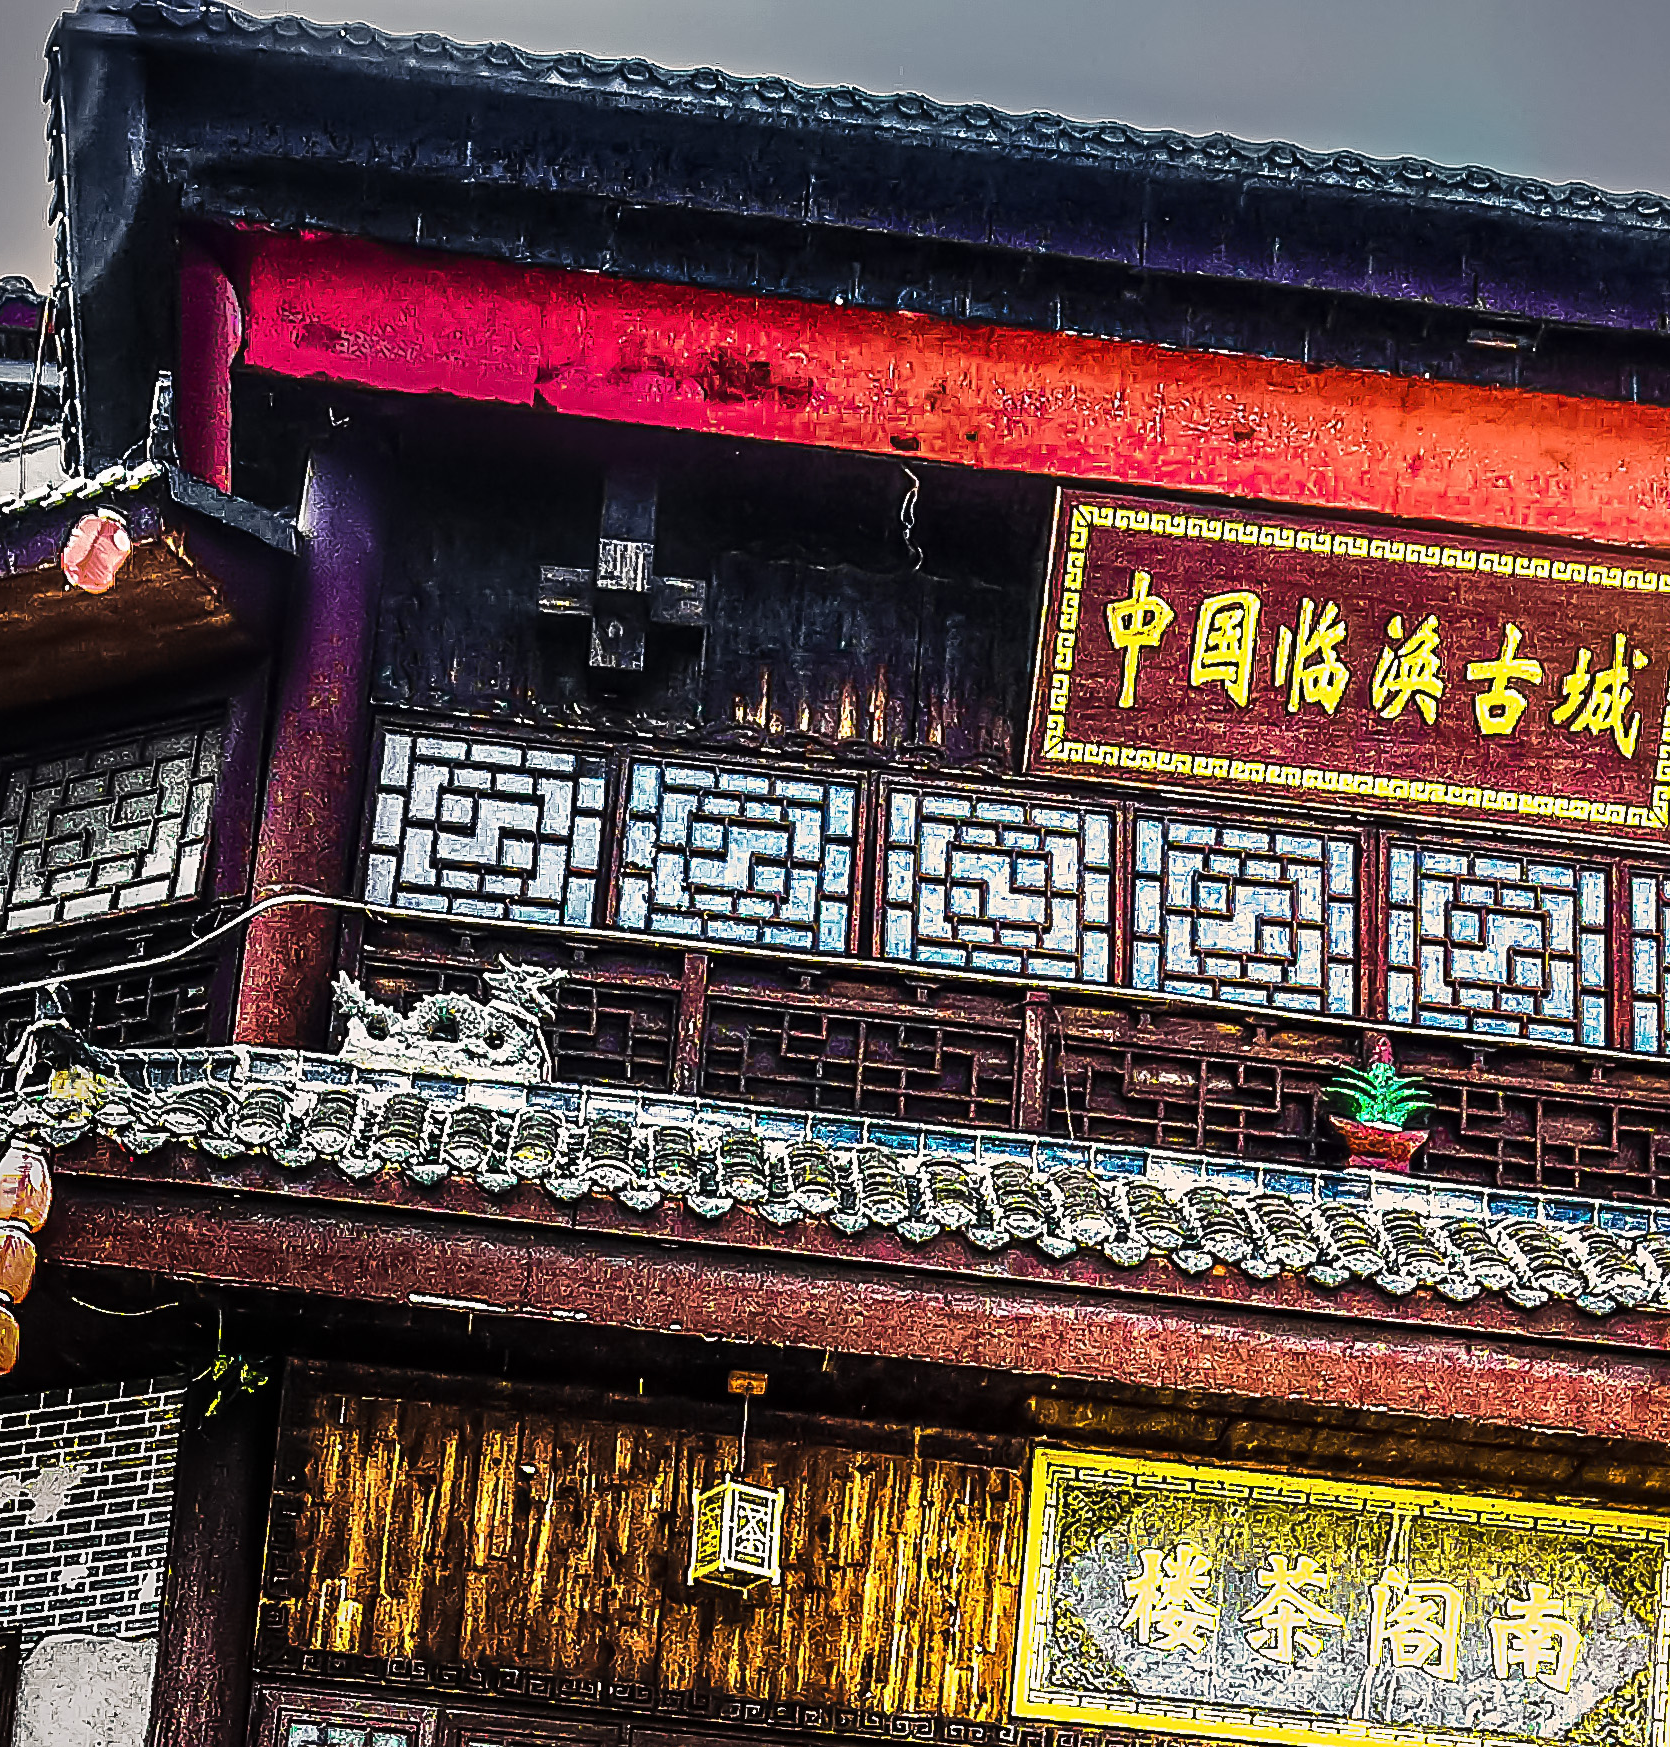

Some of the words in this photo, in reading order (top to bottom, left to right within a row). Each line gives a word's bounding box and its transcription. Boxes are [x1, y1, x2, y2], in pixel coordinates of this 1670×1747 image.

[1106, 570, 1649, 761] 中国临涣古城
